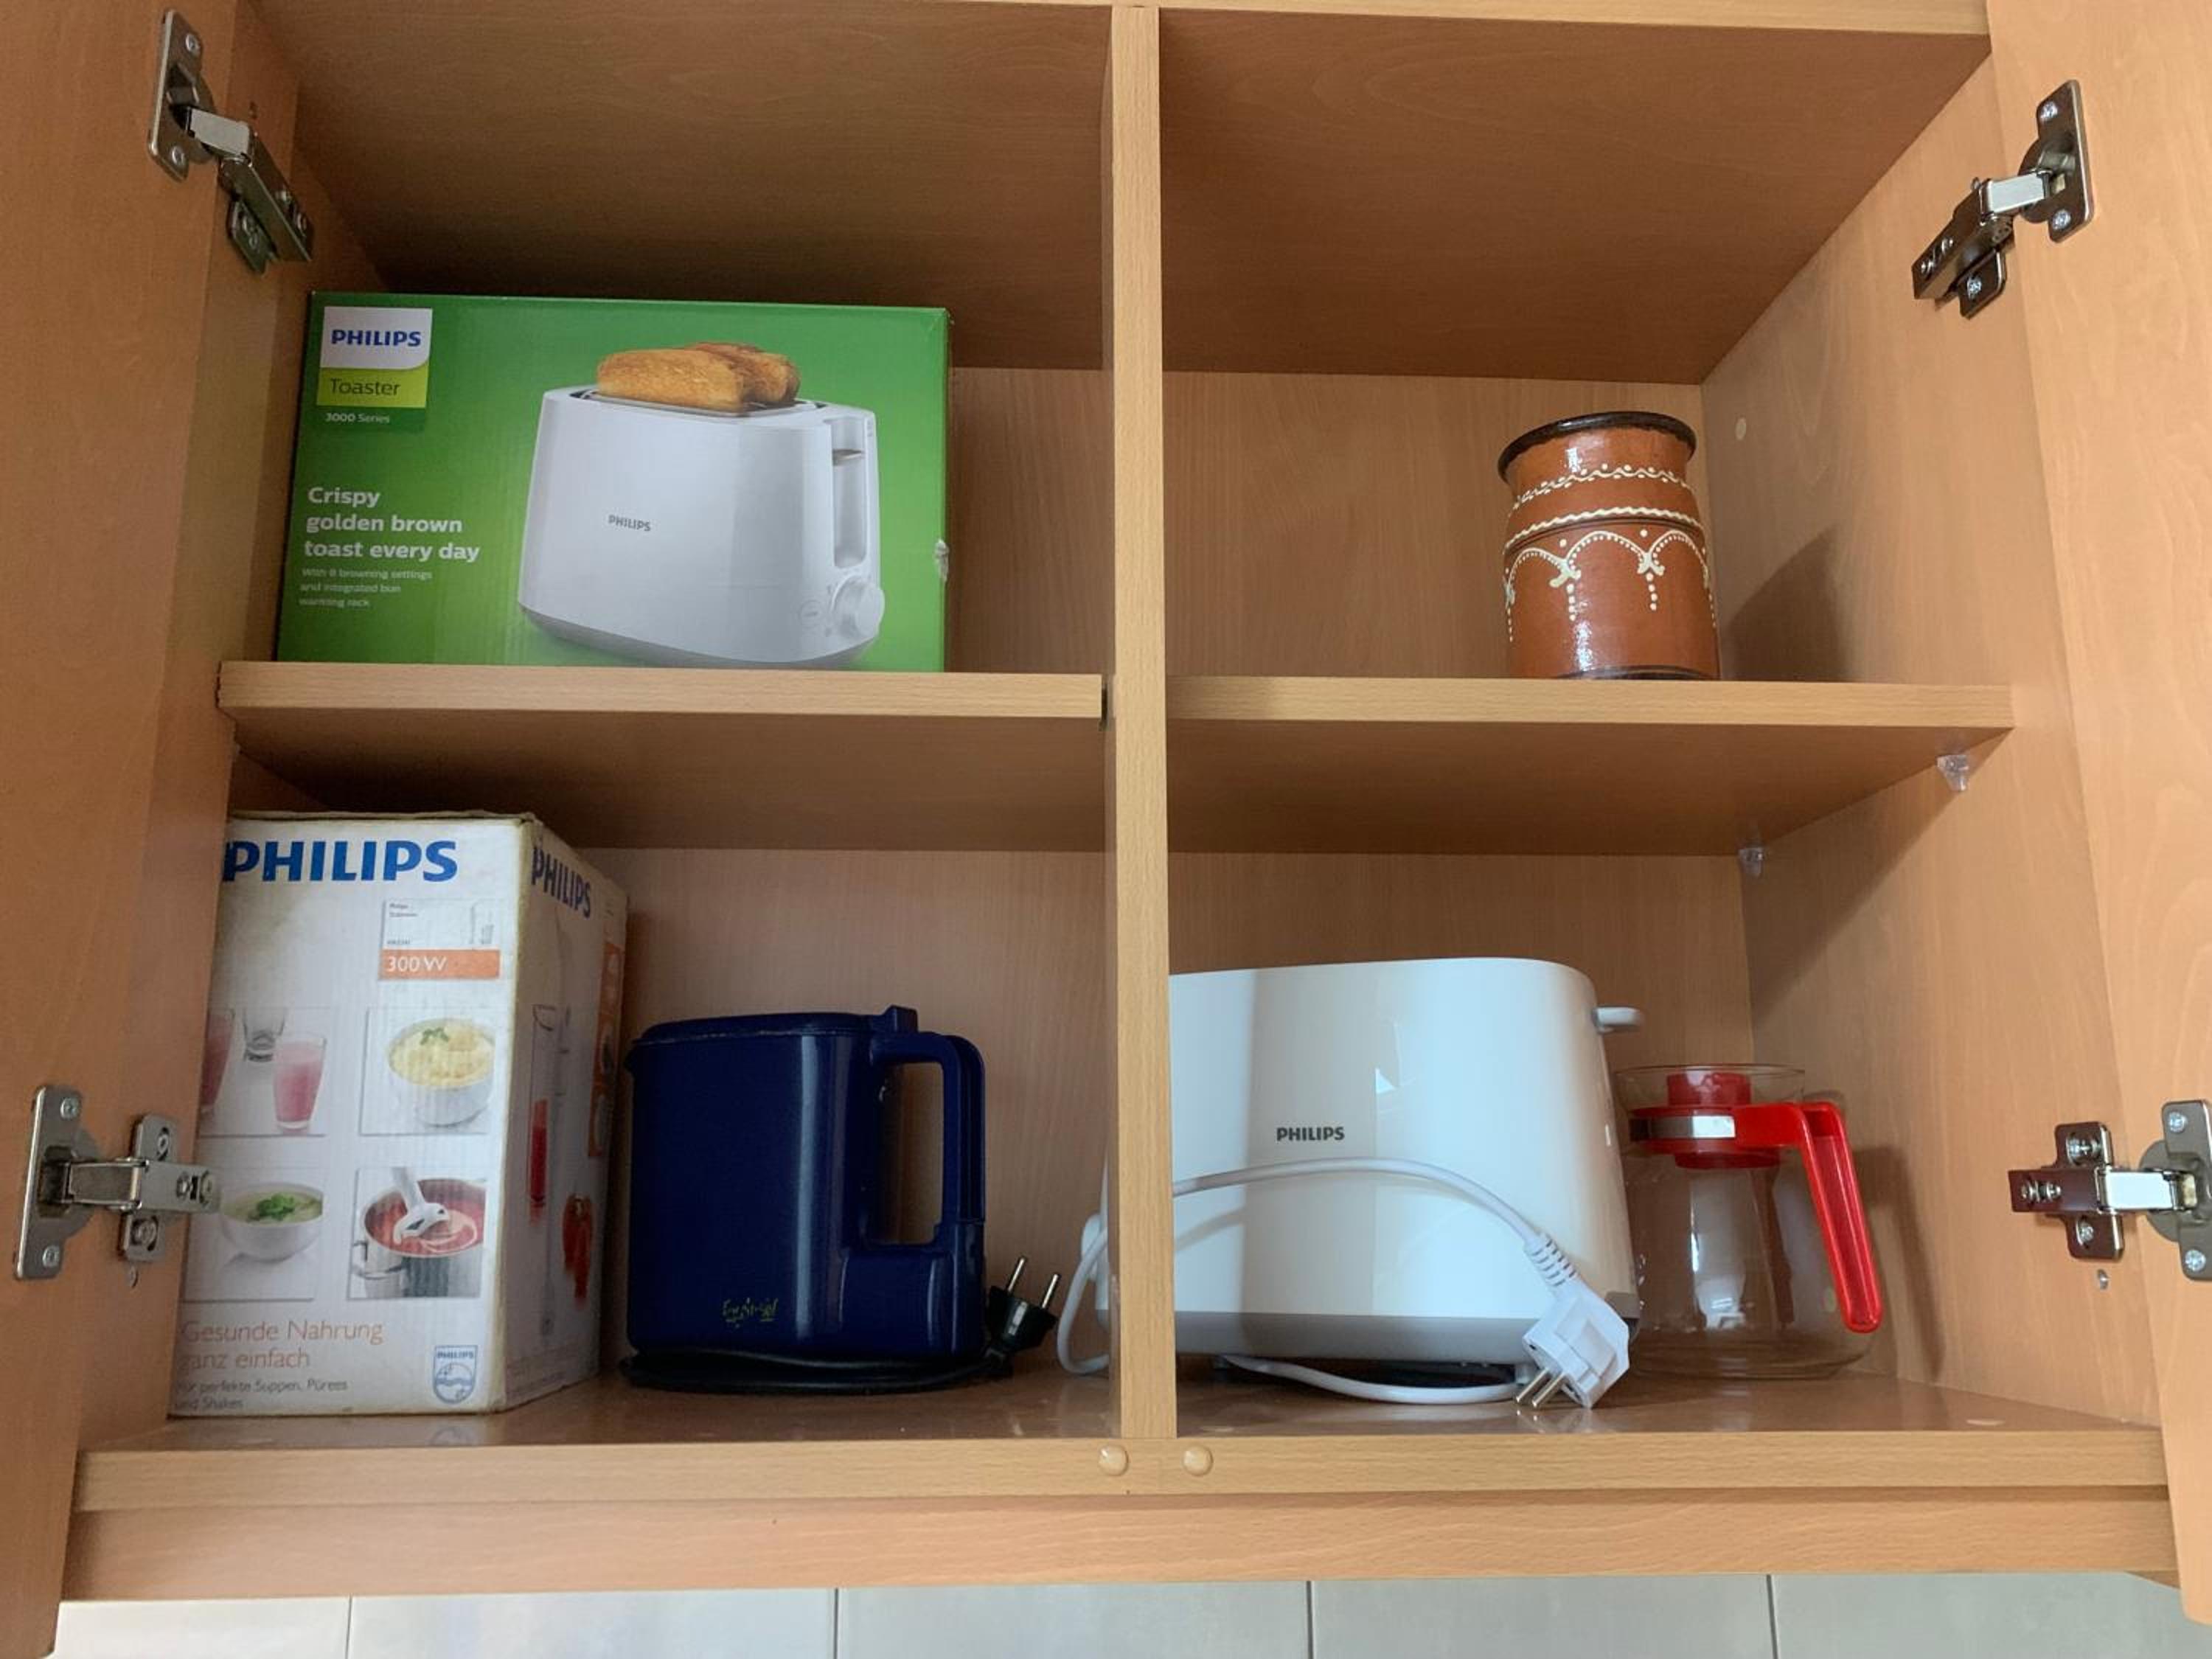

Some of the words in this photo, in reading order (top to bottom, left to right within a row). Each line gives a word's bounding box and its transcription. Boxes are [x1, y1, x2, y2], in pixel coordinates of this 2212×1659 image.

[331, 330, 421, 347] PHILIPS
[330, 378, 401, 396] Toaster
[324, 413, 355, 422] 3000
[358, 414, 390, 423] Series
[307, 487, 380, 508] Crispy
[306, 514, 384, 534] golden
[391, 515, 463, 533] brown
[608, 514, 651, 532] PHILIPS
[304, 540, 364, 557] toast
[369, 543, 434, 563] every
[438, 542, 481, 563] day
[222, 840, 459, 883] PHILIPS
[531, 846, 591, 919] PHILIPS
[1276, 1126, 1346, 1142] PHILIPS
[182, 1321, 279, 1343] Gesunde
[286, 1320, 384, 1345] Nahrung
[234, 1346, 310, 1369] einfach
